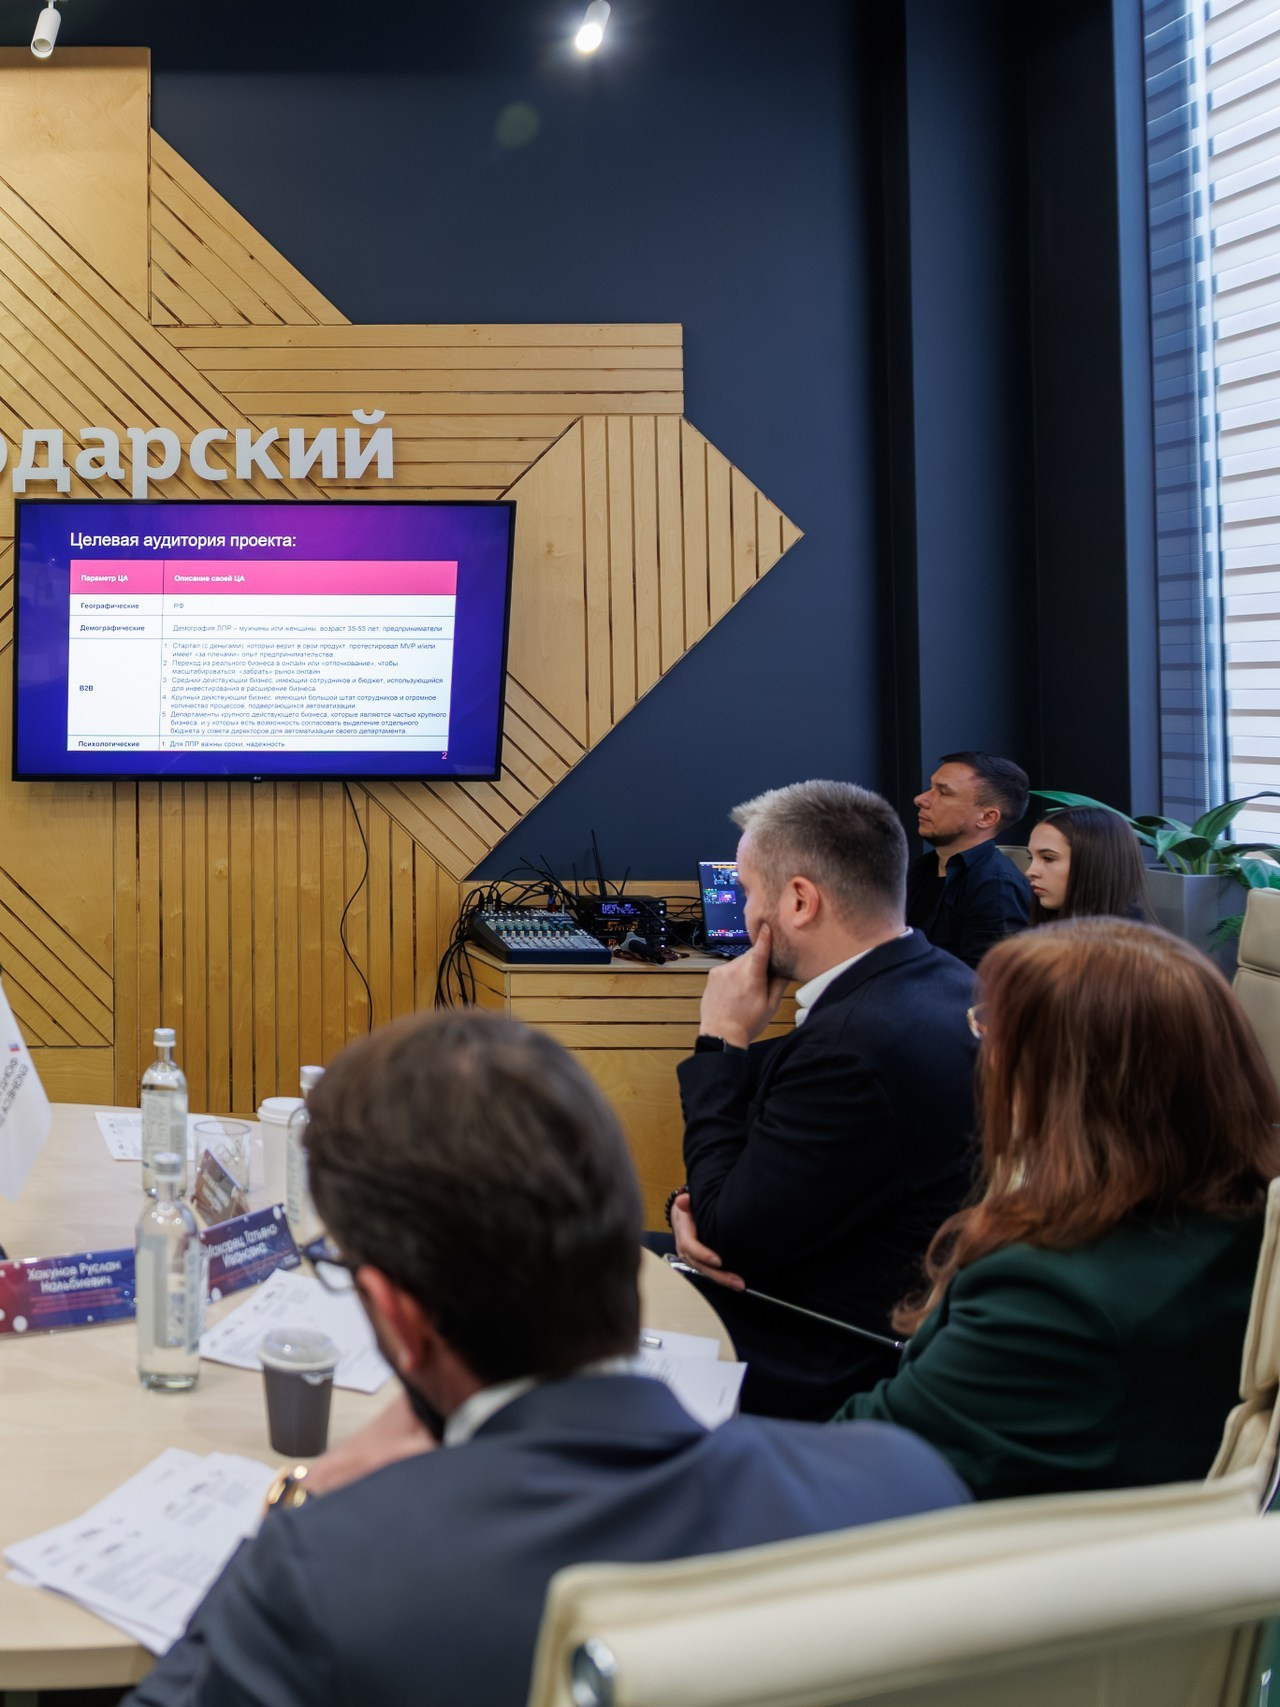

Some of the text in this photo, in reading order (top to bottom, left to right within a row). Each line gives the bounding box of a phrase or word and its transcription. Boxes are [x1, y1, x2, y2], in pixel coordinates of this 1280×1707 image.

[70, 532, 297, 550] Целевая аудитория проекта:
[81, 574, 128, 583] Параметр ЦА
[174, 574, 245, 583] Описание своей ЦА
[80, 602, 140, 610] Географические
[173, 602, 185, 610] РФ
[80, 624, 145, 632] Демографические
[78, 740, 140, 748] Психологические
[441, 752, 448, 760] 2
